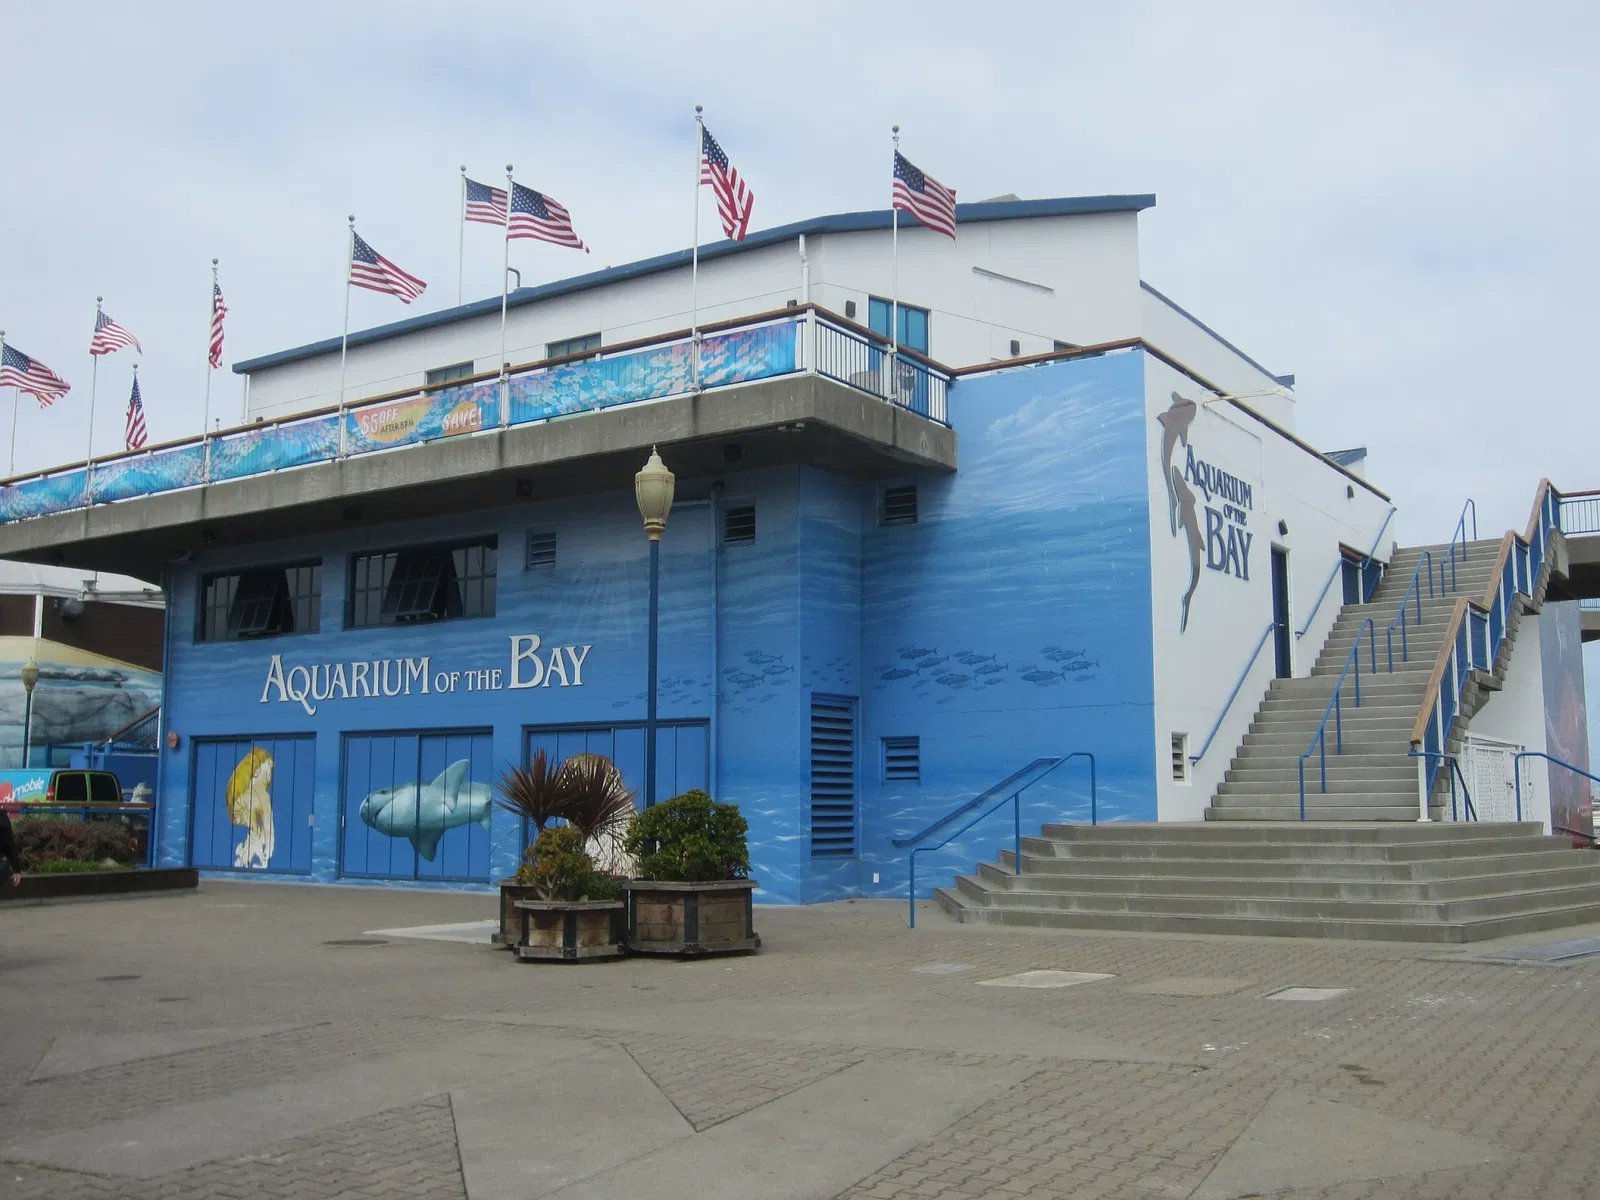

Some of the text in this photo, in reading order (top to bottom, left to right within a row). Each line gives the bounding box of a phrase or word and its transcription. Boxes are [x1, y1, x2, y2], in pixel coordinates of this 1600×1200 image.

[361, 408, 399, 436] $5 OFF
[380, 423, 400, 435] AFTER
[442, 407, 482, 431] SAVE!
[1184, 444, 1253, 510] AQUARIUM
[1223, 503, 1247, 526] OF THE
[1205, 505, 1253, 581] BAY
[260, 633, 593, 716] AQUARIUM OF THE BAY
